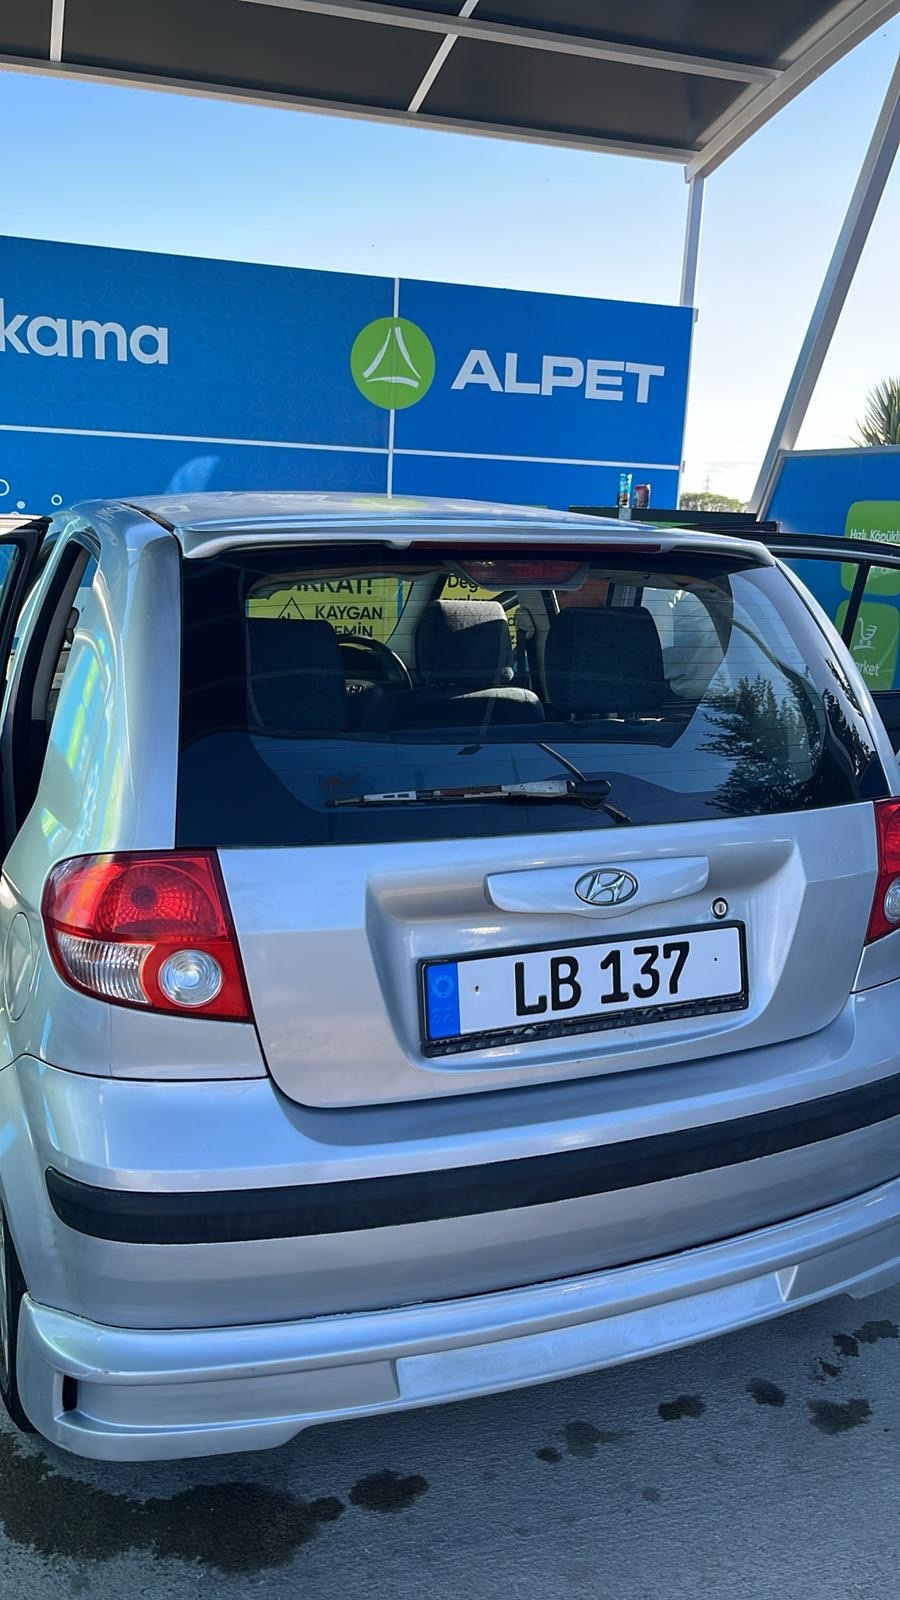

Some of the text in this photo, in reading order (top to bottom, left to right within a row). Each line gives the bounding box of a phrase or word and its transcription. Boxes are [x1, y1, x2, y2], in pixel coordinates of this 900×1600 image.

[0, 297, 169, 365] kama
[450, 349, 665, 403] ALPET
[315, 605, 383, 620] KAYGAN
[514, 941, 690, 1016] LB 137
